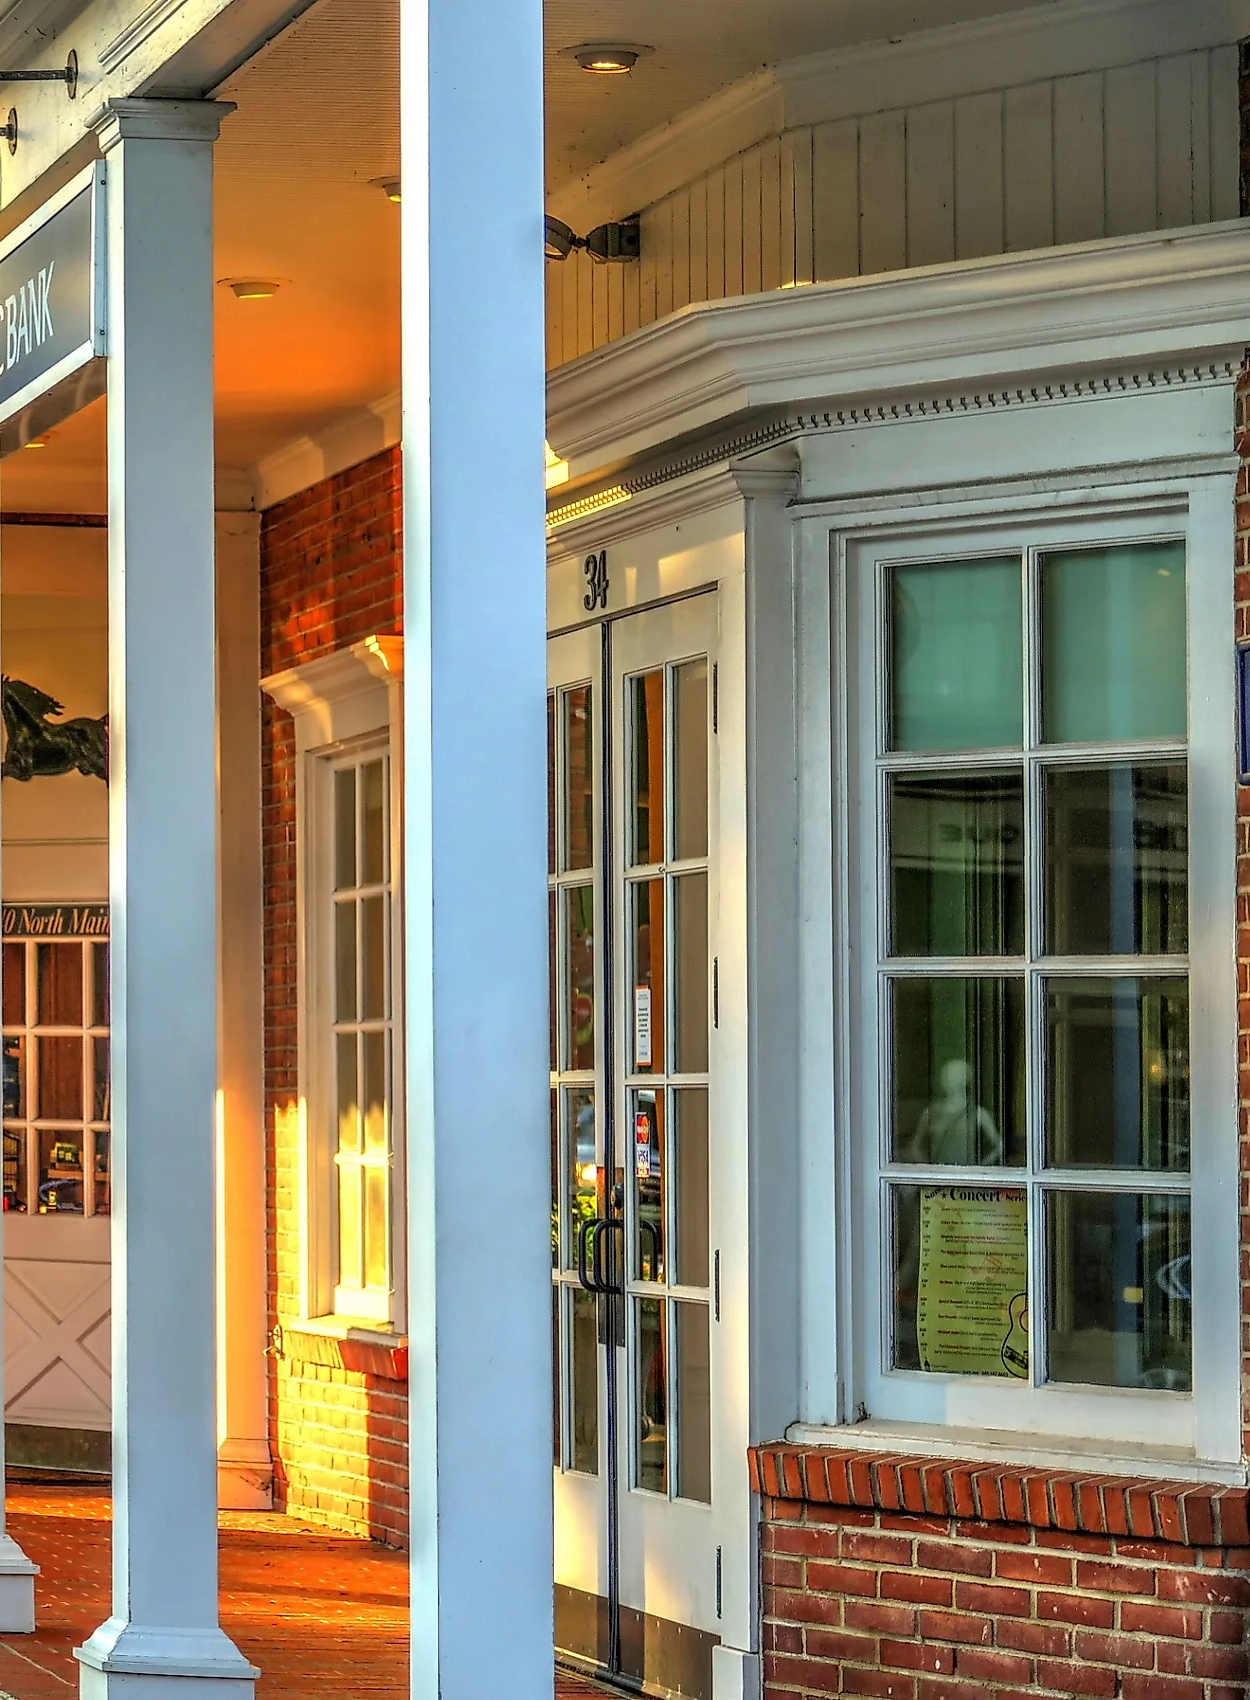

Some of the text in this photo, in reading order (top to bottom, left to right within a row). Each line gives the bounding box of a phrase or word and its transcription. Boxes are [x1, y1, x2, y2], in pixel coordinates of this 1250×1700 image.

[5, 260, 55, 370] BANK
[583, 549, 610, 611] 34
[17, 907, 63, 934] North
[949, 1187, 1001, 1203] Concert
